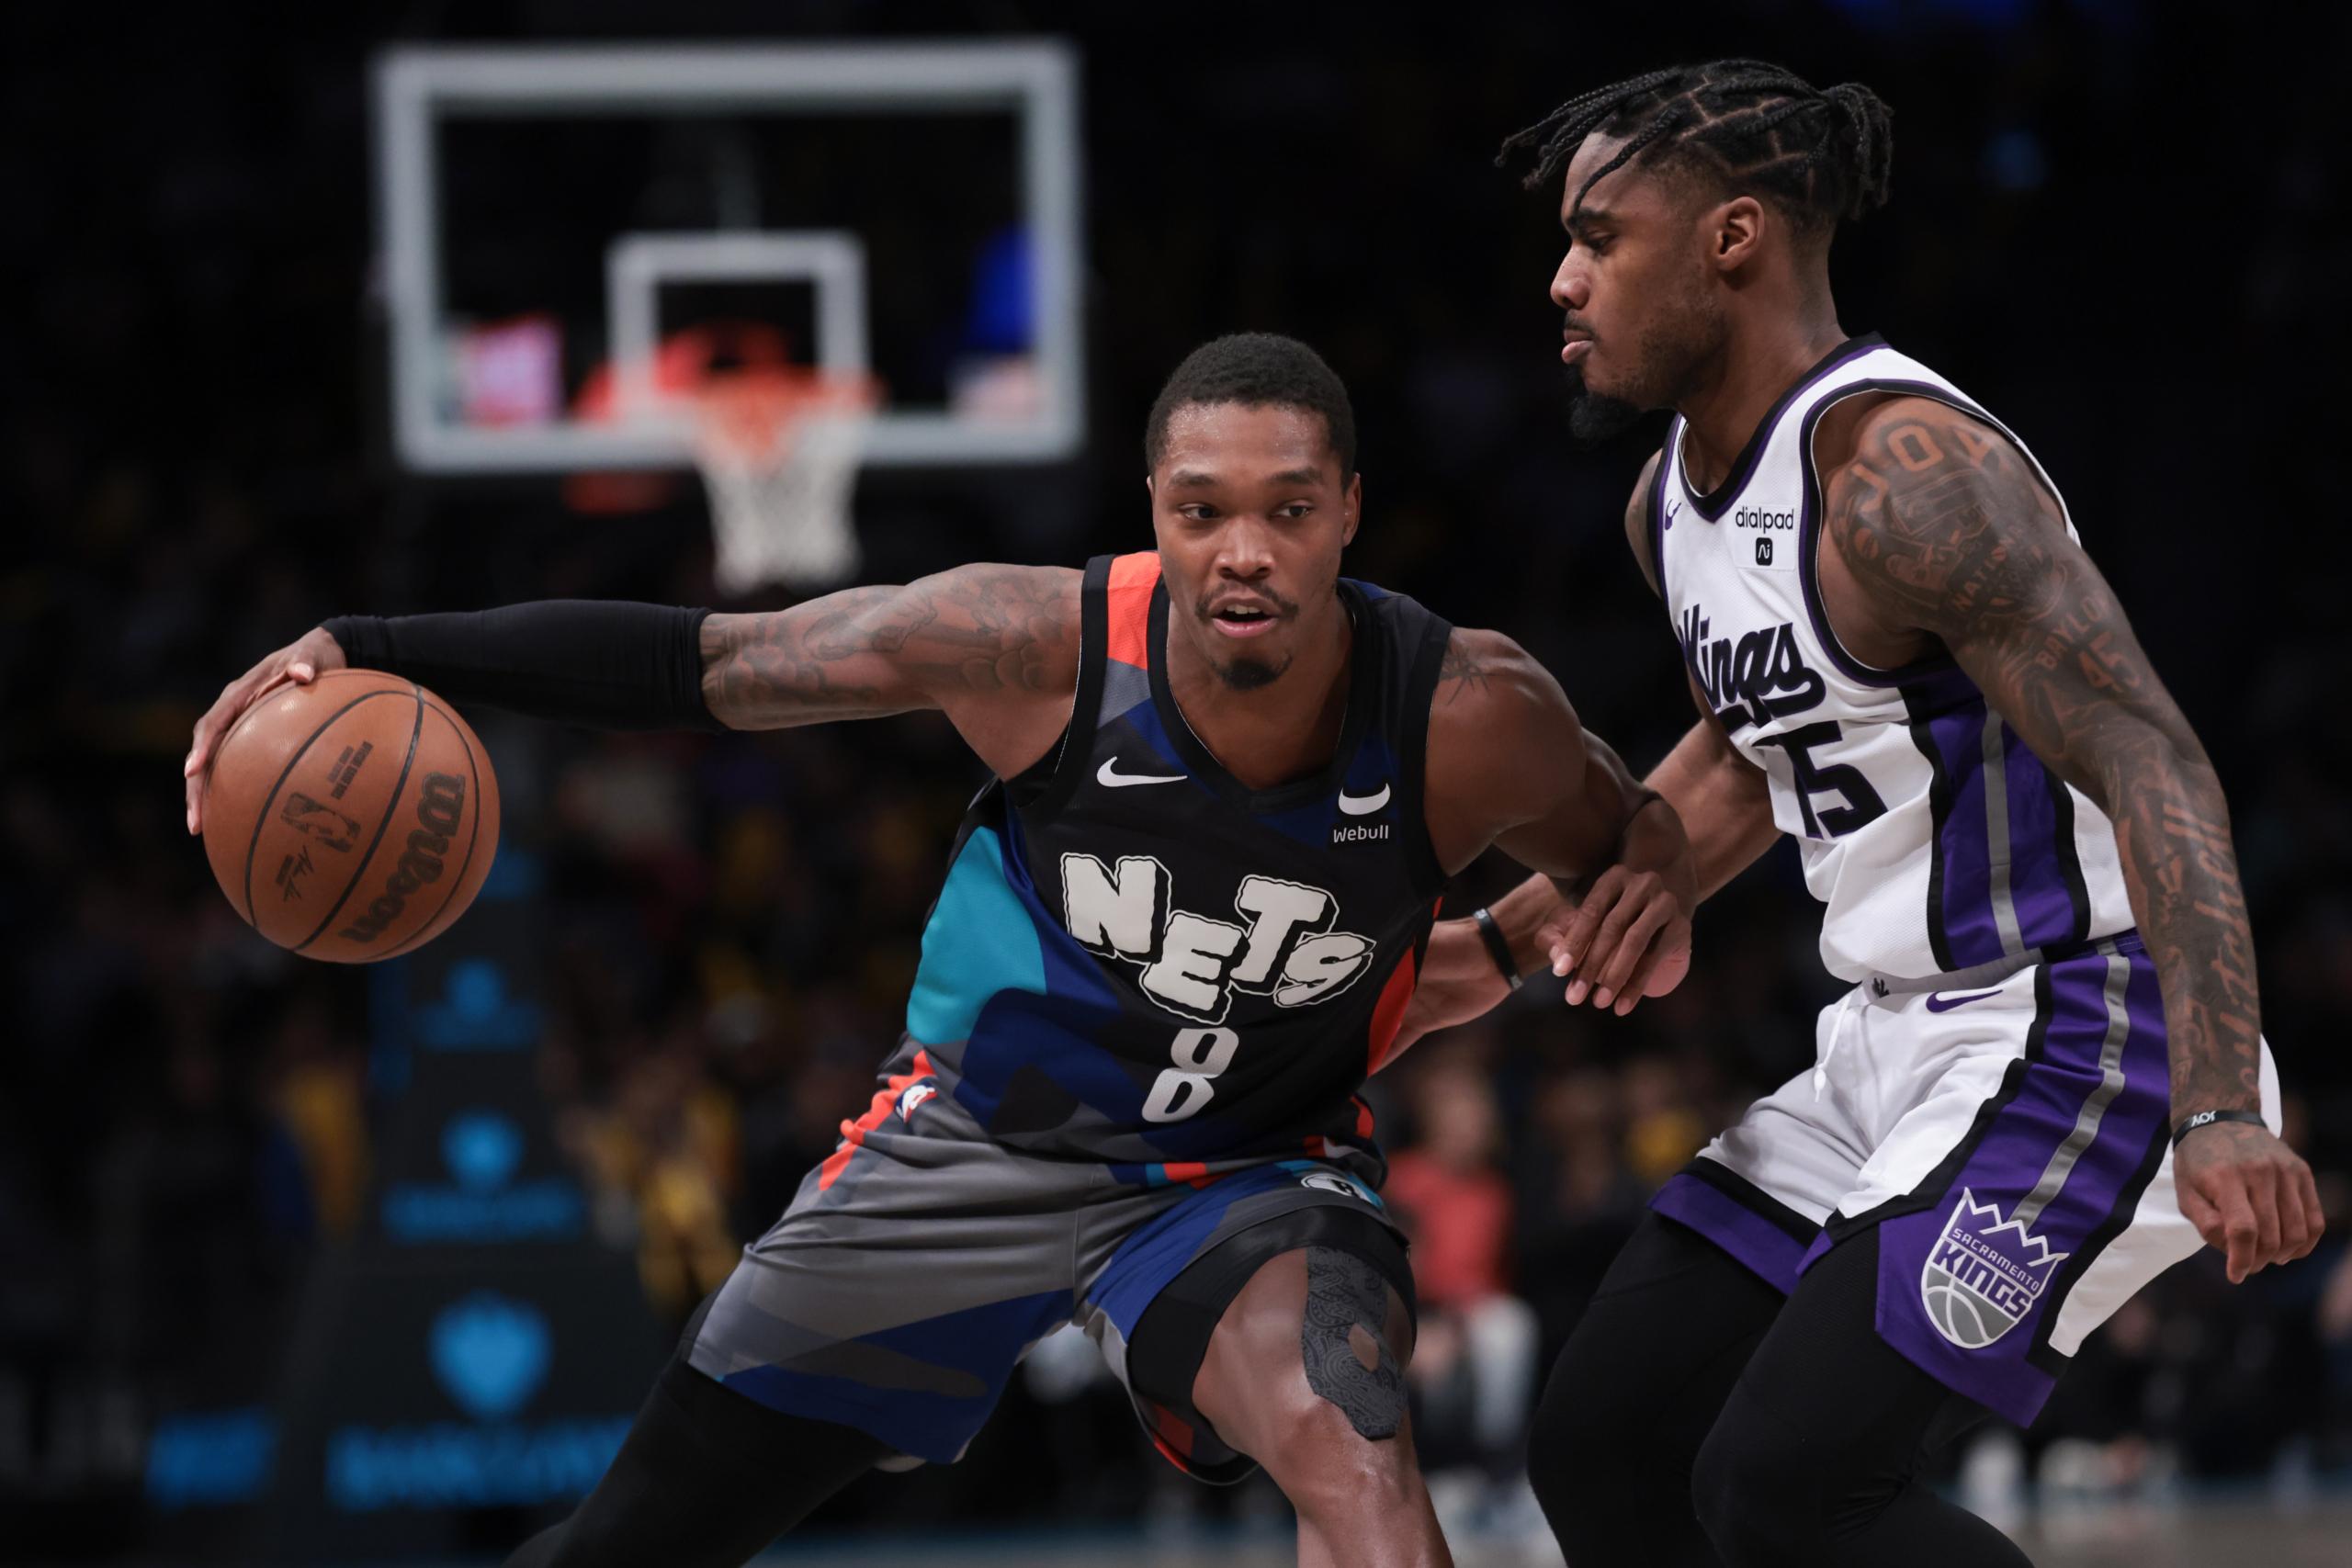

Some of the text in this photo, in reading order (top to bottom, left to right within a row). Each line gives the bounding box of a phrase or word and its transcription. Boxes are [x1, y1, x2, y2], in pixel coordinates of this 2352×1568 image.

[1736, 506, 1794, 534] dialpad
[338, 772, 466, 942] Wilson
[1333, 825, 1389, 843] Webull
[1061, 852, 1376, 1024] NETS
[1142, 1027, 1239, 1122] 8
[2190, 1110, 2216, 1126] JOY
[1933, 1240, 2033, 1319] KINGS
[1952, 1228, 2040, 1292] SACRAMENTO
